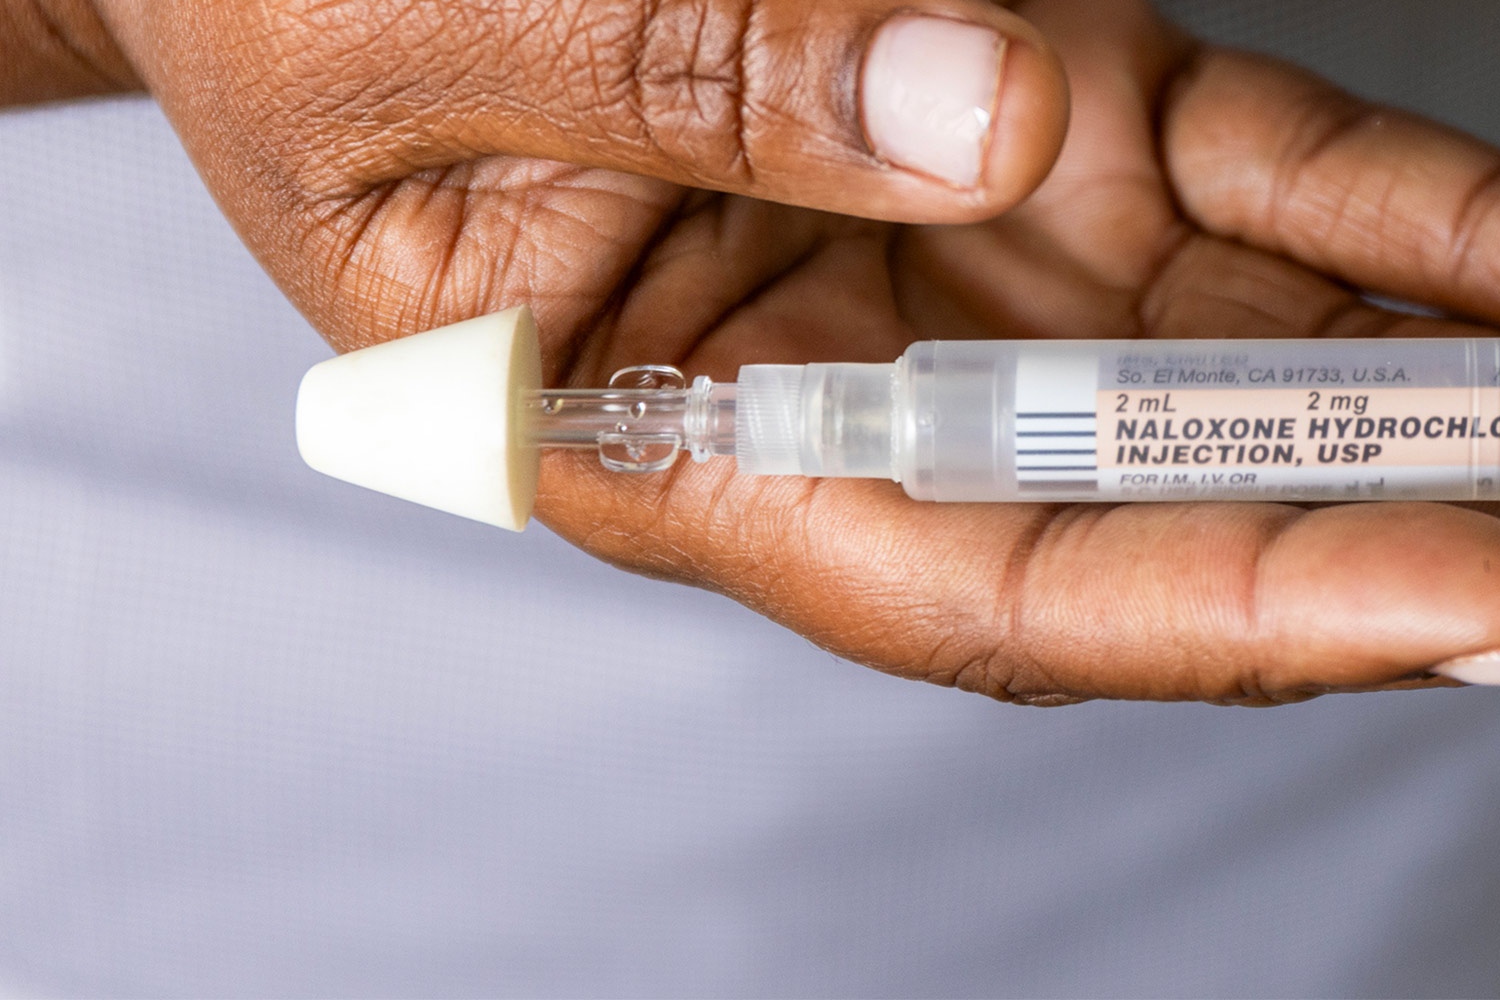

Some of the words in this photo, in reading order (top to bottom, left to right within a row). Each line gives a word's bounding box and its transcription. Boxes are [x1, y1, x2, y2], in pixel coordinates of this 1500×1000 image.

[1116, 368, 1147, 384] So.
[1153, 368, 1173, 384] El
[1177, 369, 1241, 386] Monte,
[1248, 367, 1276, 383] CA
[1282, 367, 1345, 385] 91733,
[1352, 366, 1412, 382] U.S.A.
[1115, 393, 1130, 413] 2
[1138, 393, 1177, 413] mL
[1307, 391, 1321, 411] 2
[1329, 394, 1370, 416] mg
[1115, 418, 1297, 440] NALOXONE
[1115, 443, 1304, 467] INJECTION,
[1316, 443, 1383, 464] USP
[1119, 473, 1159, 485] FOR
[1229, 472, 1258, 485] OR
